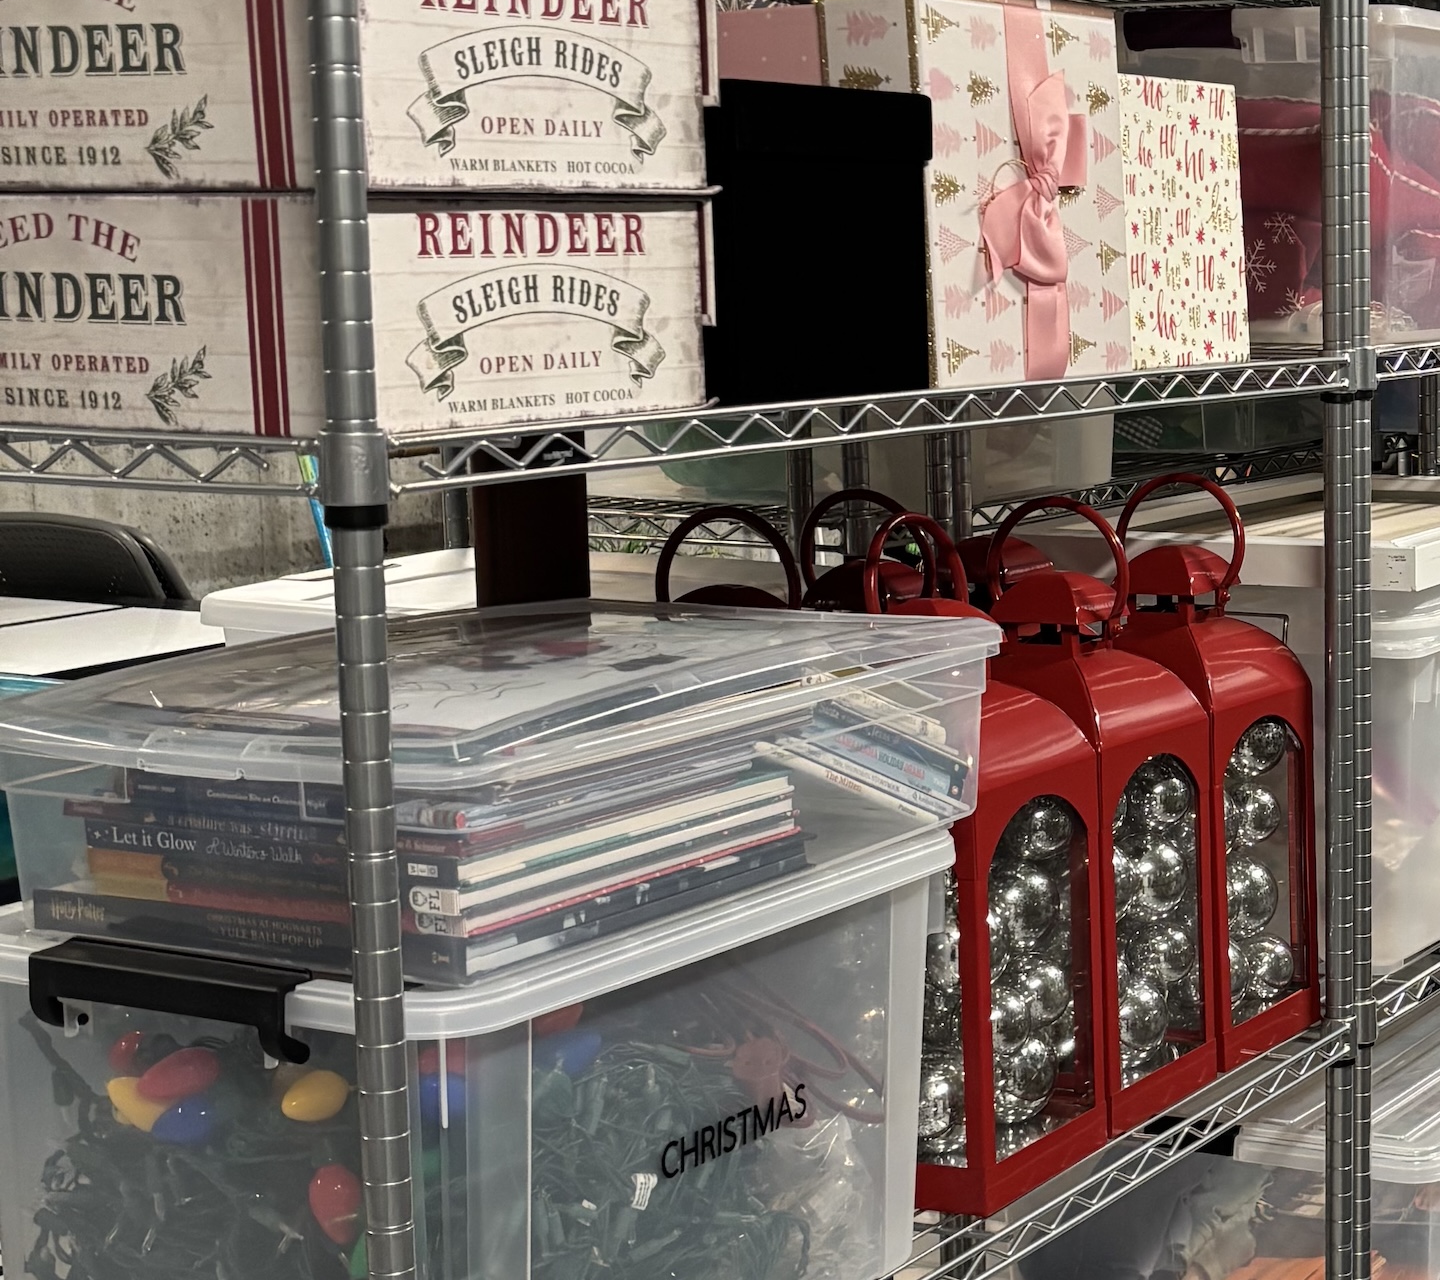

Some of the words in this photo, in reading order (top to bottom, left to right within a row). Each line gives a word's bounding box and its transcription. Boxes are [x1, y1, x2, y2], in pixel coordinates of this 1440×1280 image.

[0, 22, 188, 79] NDEER
[454, 36, 543, 81] SLEIGH
[555, 38, 624, 89] RIDES
[51, 108, 149, 129] OPERATED
[481, 115, 535, 137] OPEN
[545, 120, 604, 139] DAILY
[1, 145, 68, 167] SINCE
[78, 145, 122, 166] 1912
[450, 157, 490, 173] WARM
[493, 158, 558, 174] BLANKETS
[567, 160, 592, 174] HOT
[595, 160, 636, 175] COCOA
[68, 213, 142, 263] THE
[416, 211, 647, 258] REINDEER
[452, 273, 540, 324] SLEIGH
[552, 274, 621, 317] RIDES
[52, 353, 150, 375] OPERATED
[479, 354, 534, 375] OPEN
[543, 350, 603, 371] DAILY
[4, 387, 70, 409] SINCE
[80, 389, 123, 410] 1912
[448, 398, 488, 415] WARM
[491, 394, 557, 412] BLANKETS
[565, 391, 591, 406] HOT
[593, 388, 634, 403] COCOA
[111, 826, 137, 846] Let
[140, 830, 153, 848] it
[156, 831, 197, 852] Glow
[660, 1083, 807, 1179] CHRISTMAS
